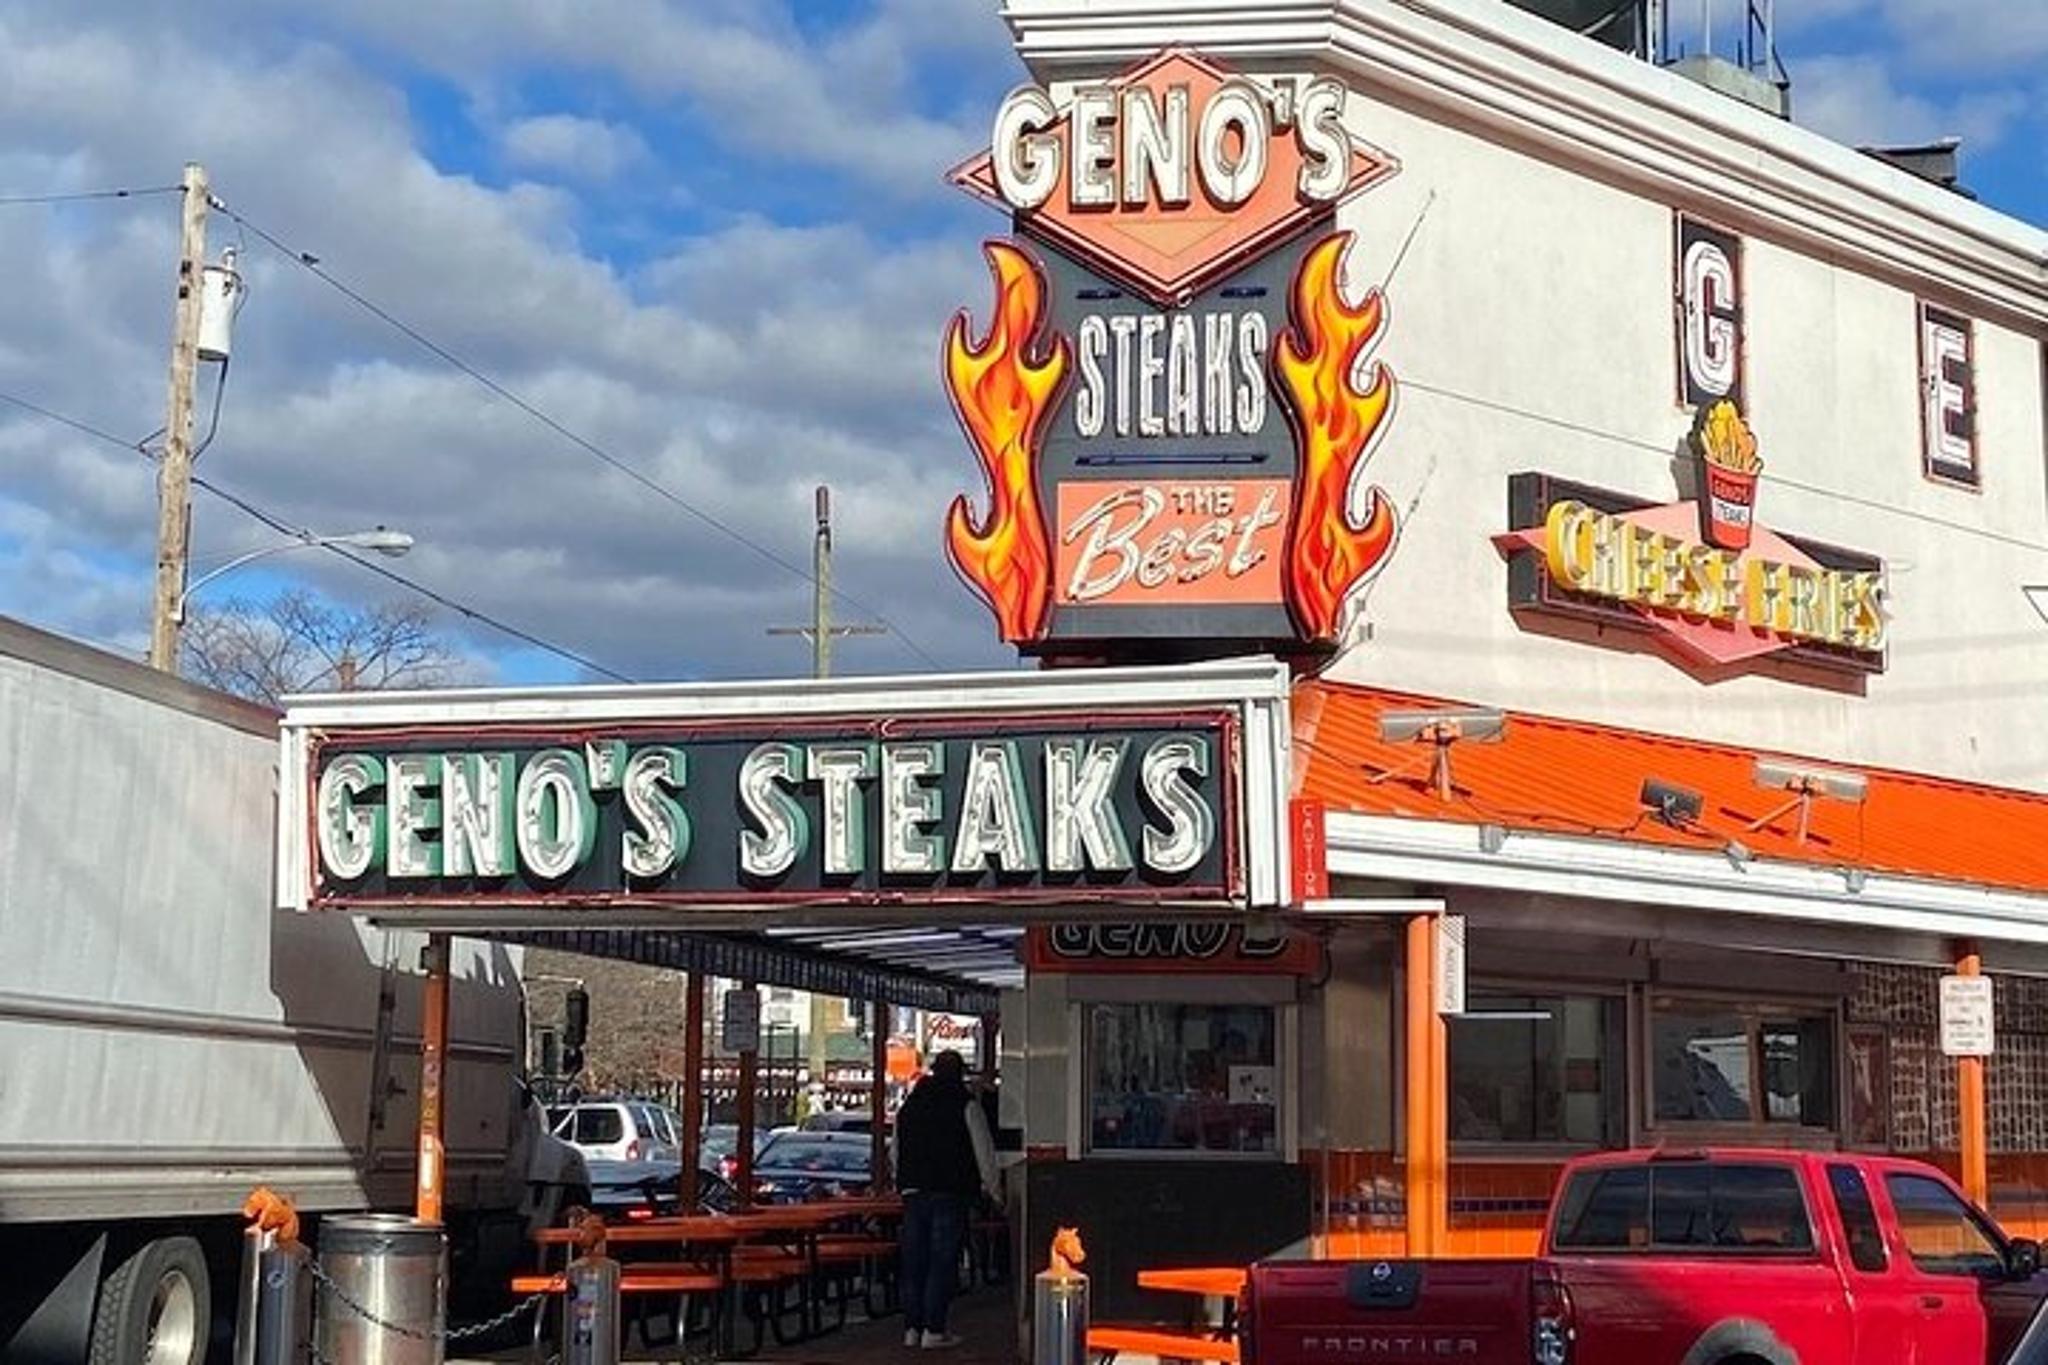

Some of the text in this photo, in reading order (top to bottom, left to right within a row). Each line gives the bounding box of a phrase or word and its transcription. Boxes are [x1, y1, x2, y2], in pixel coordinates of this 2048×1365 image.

[991, 76, 1352, 209] GENO'S
[1076, 310, 1269, 438] STEAKS
[1063, 486, 1282, 602] Best
[1171, 486, 1235, 516] THE
[1546, 500, 1886, 648] CHEESE FRIES
[318, 733, 1215, 880] GENO'S STEAKS
[1301, 804, 1317, 897] CAUTION
[1302, 1337, 1478, 1355] FRONTIER
